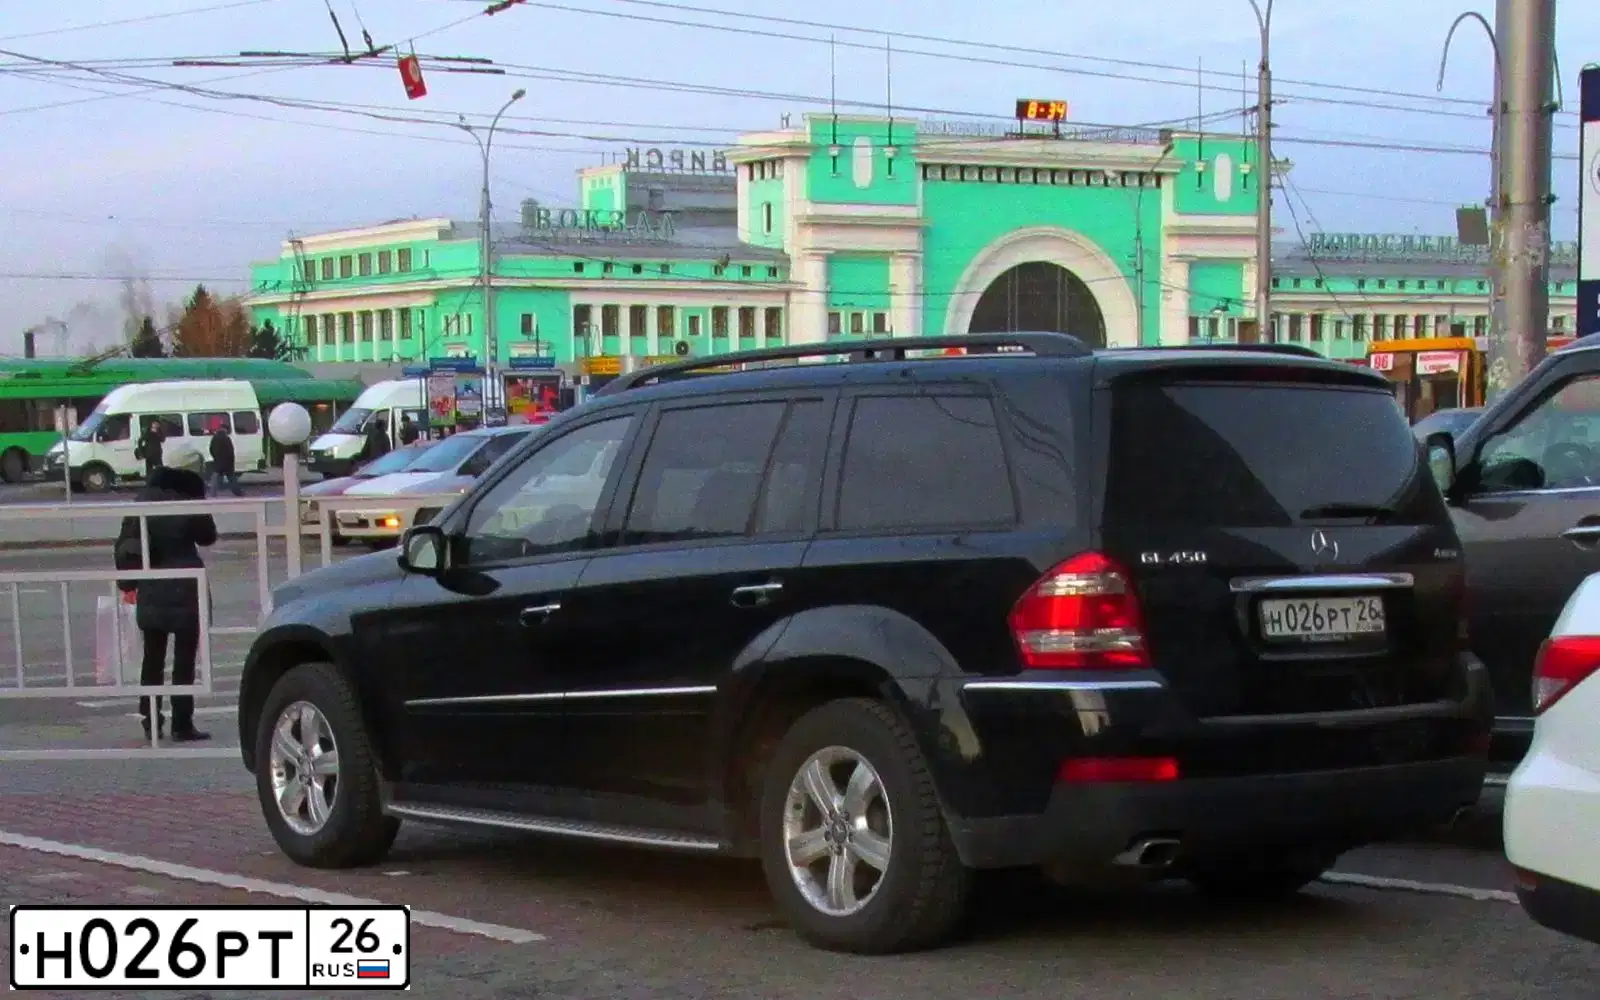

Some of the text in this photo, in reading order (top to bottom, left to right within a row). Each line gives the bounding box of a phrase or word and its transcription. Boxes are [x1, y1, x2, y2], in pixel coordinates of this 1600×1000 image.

[536, 208, 675, 237] ВОКЗАЛ
[1374, 355, 1388, 369] 96
[1141, 551, 1207, 563] GL 450
[1357, 599, 1379, 621] 26
